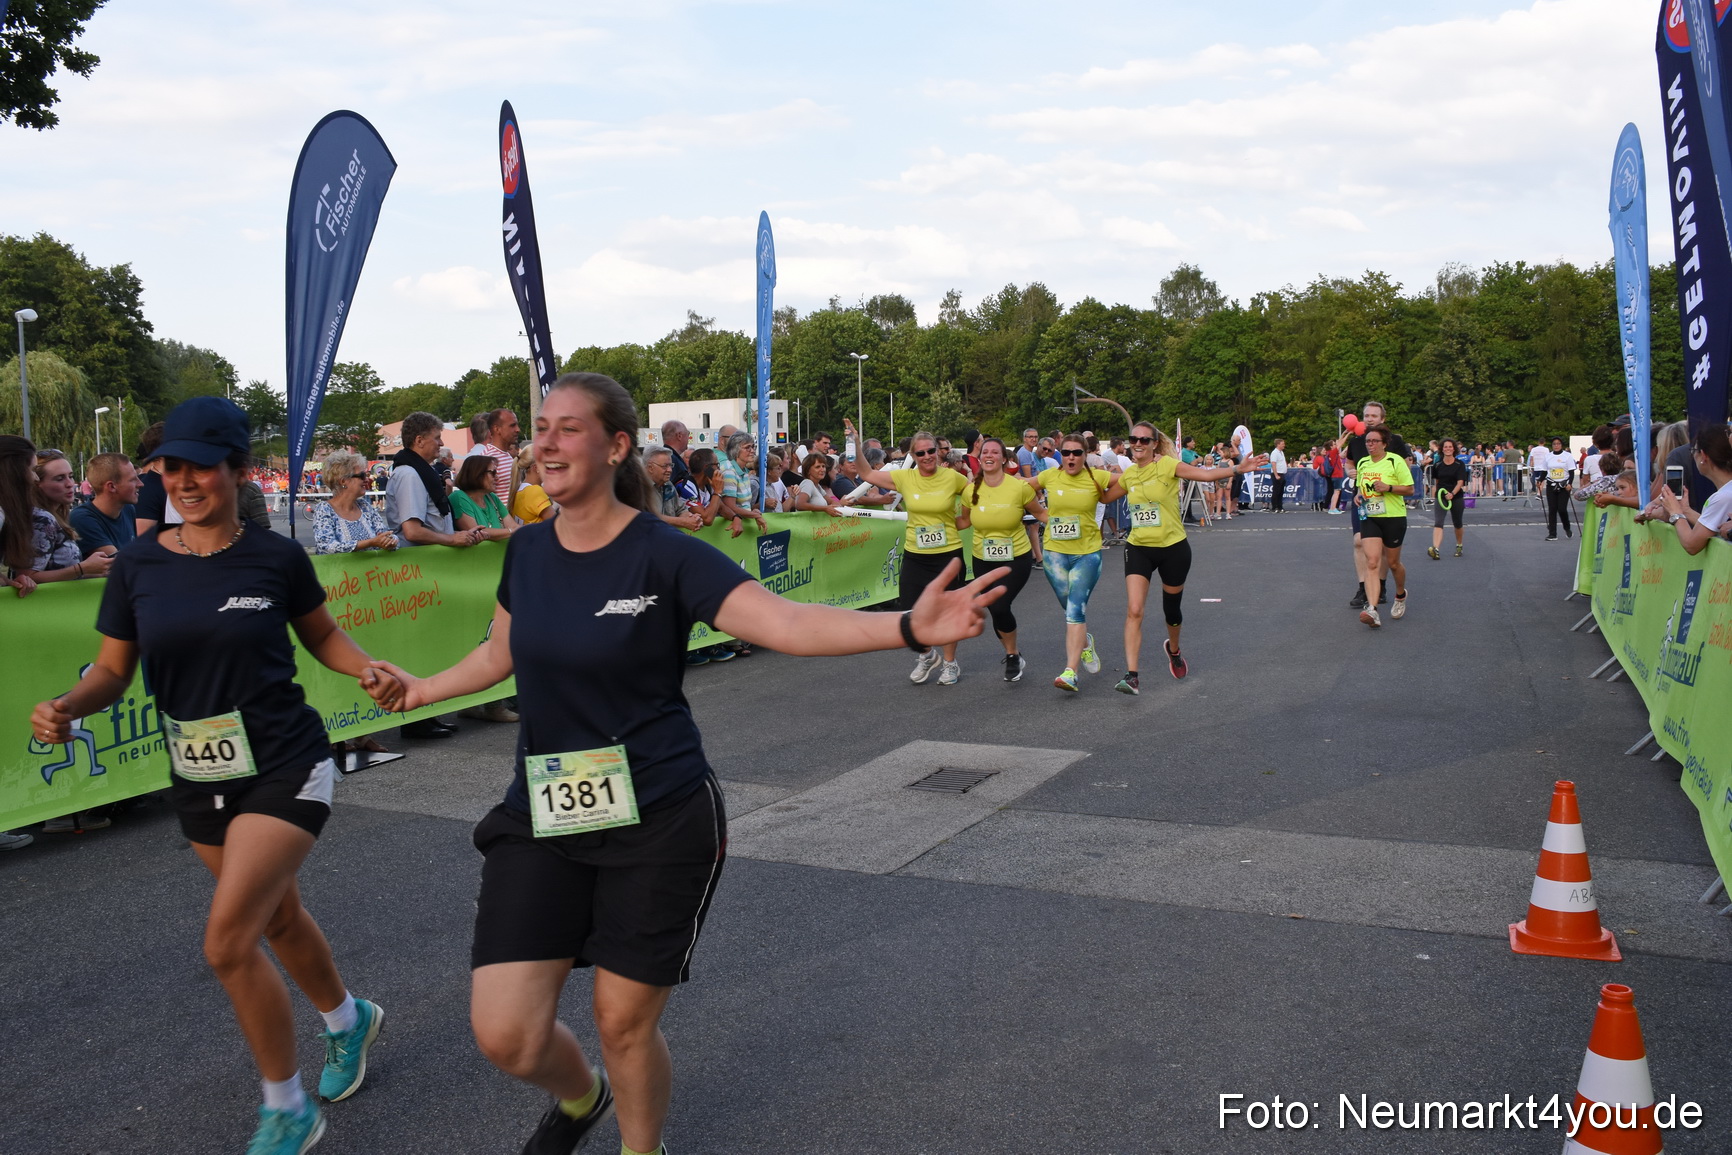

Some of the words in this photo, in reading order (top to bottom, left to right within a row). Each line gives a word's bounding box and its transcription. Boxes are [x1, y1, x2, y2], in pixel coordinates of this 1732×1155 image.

[325, 148, 361, 237] Fischer
[340, 165, 367, 236] AUTOMOBILE
[1134, 510, 1157, 521] 1235
[919, 532, 943, 543] 1203
[1053, 524, 1076, 534] 1224
[763, 544, 785, 557] Fischer
[986, 545, 1009, 555] 1261
[365, 564, 423, 591] Firmen
[762, 557, 815, 595] menlauf
[380, 580, 442, 621] länger!
[173, 739, 236, 765] 1440
[541, 777, 615, 813] 1381
